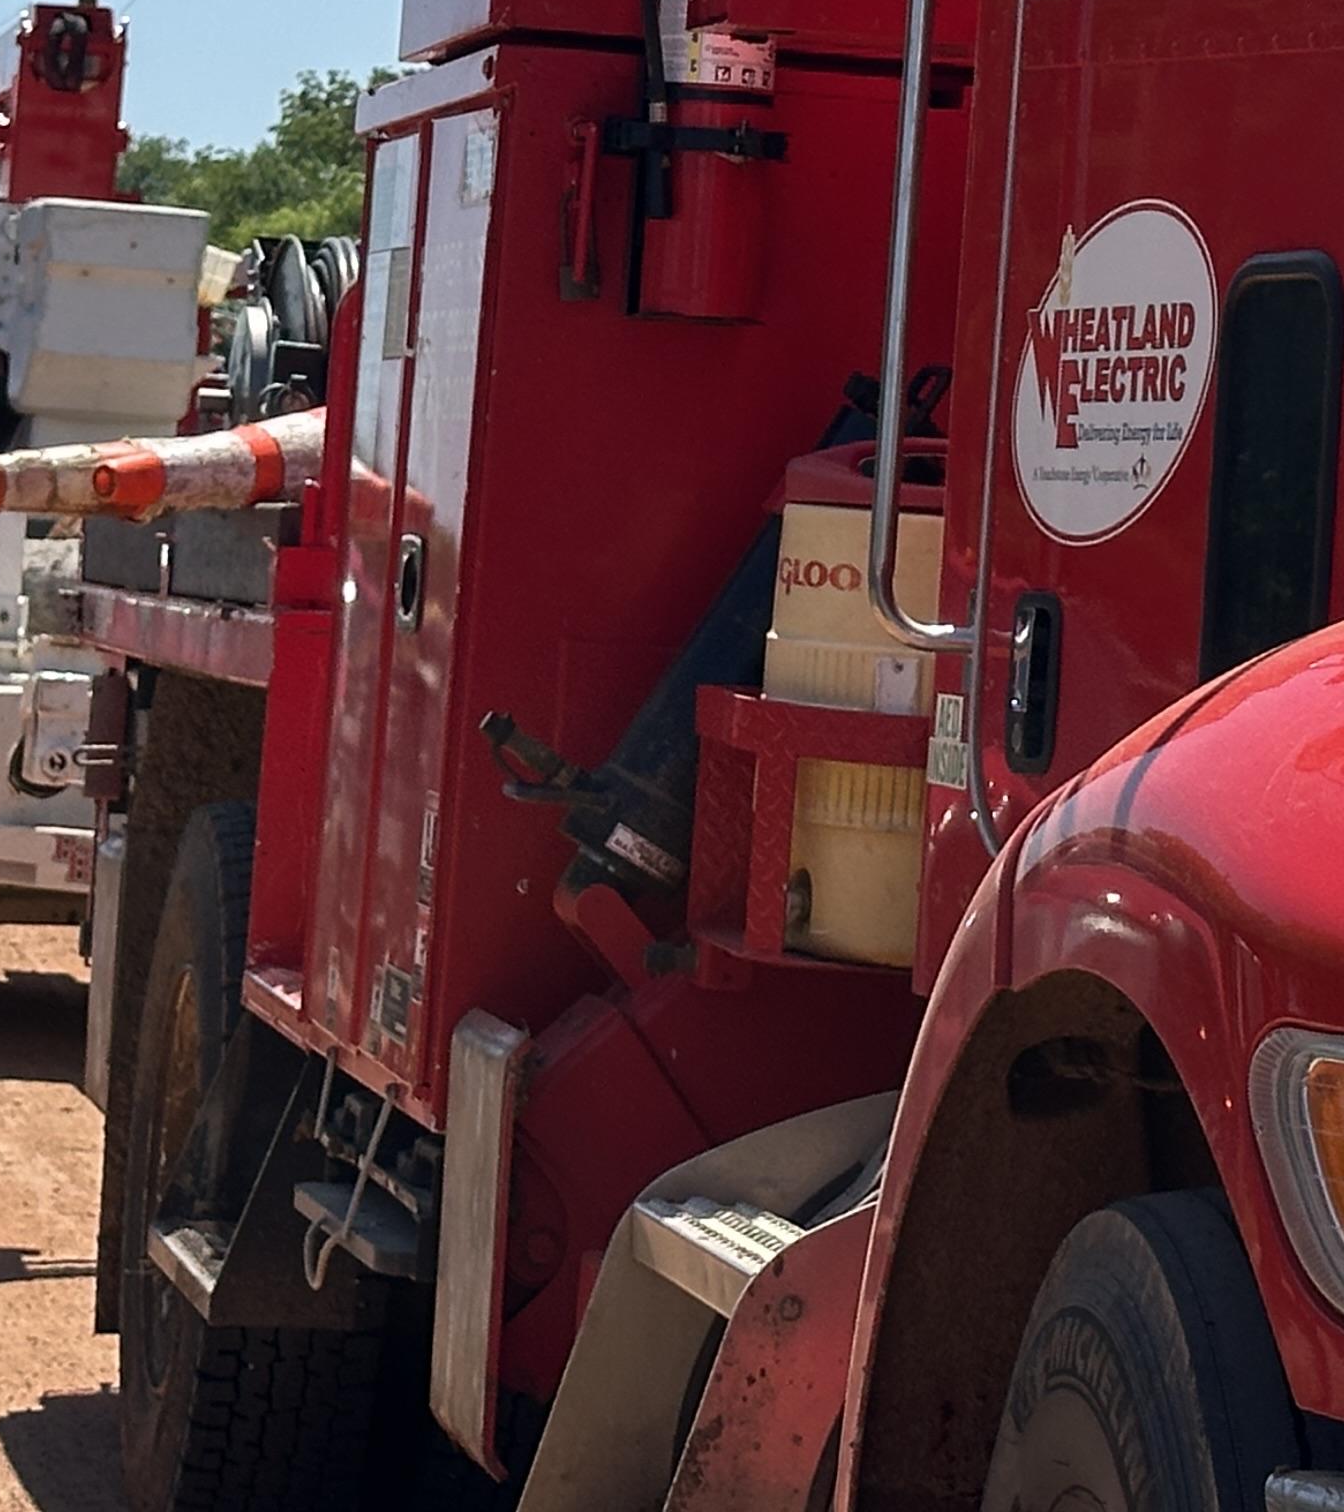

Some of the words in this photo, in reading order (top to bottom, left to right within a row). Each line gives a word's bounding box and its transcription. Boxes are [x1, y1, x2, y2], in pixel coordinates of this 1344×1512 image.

[1027, 302, 1195, 425] WHEATLAND
[1056, 354, 1187, 448] ELECTRIC
[780, 557, 862, 594] GLOO
[940, 696, 960, 738] AED
[931, 740, 967, 786] INSIDE
